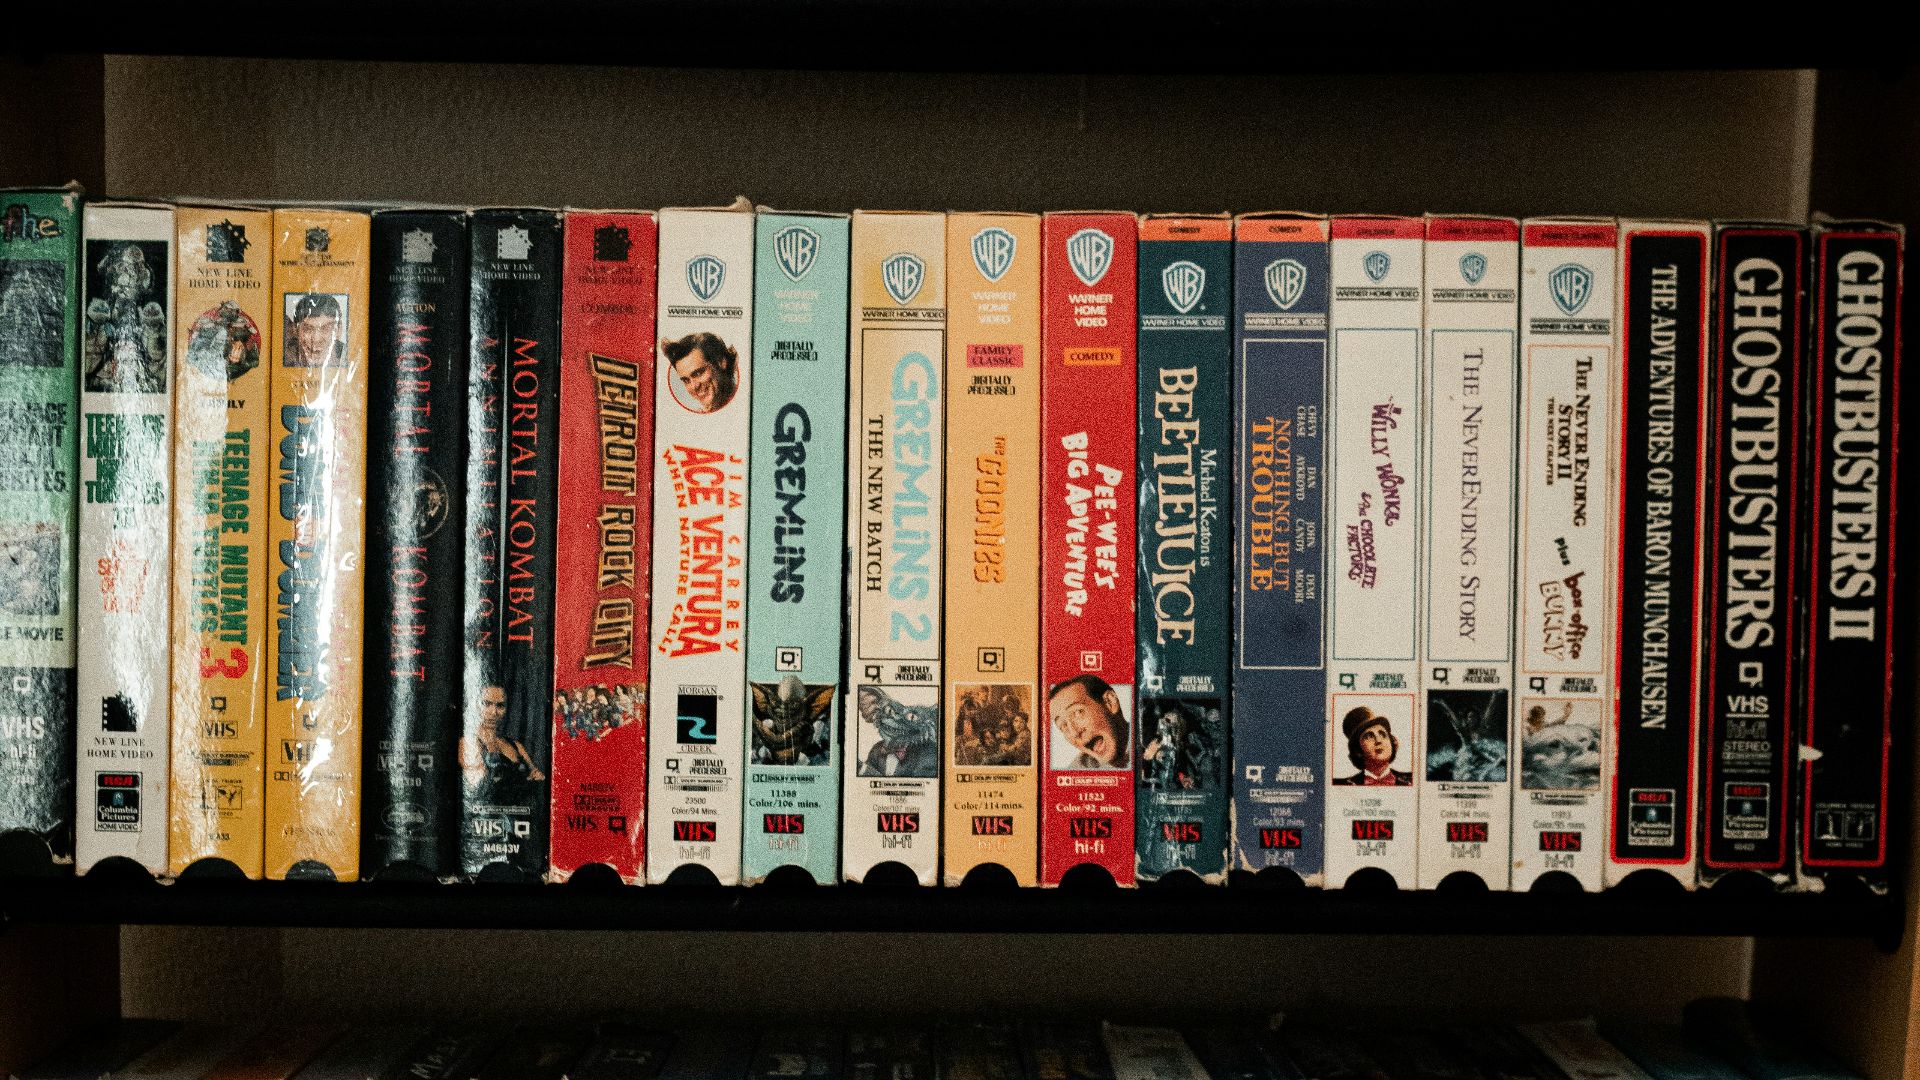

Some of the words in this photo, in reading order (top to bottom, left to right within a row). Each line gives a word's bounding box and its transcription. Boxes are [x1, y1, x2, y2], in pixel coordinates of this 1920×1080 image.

[198, 268, 222, 277] NEW
[226, 268, 252, 278] LINE
[777, 229, 817, 280] WB
[974, 230, 1013, 280] WB
[1070, 232, 1110, 284] WB
[189, 279, 220, 288] HOME
[226, 280, 261, 289] VIDEO
[484, 272, 509, 280] HOME
[689, 258, 723, 299] WB
[885, 256, 922, 302] WB
[1166, 264, 1202, 309] WB
[1268, 262, 1303, 306] WB
[1552, 267, 1589, 313] WB
[1651, 263, 1678, 310] THE
[1069, 294, 1113, 303] WARNER
[1074, 306, 1107, 316] HOME
[978, 316, 1012, 324] VIDEO
[1075, 318, 1108, 327] VIDEO
[1142, 319, 1175, 327] WARNER
[1245, 318, 1275, 326] WARNER
[1277, 318, 1301, 326] HOME
[972, 356, 1015, 366] CLASSIC
[974, 346, 1013, 354] FAMILY
[1070, 352, 1115, 362] COMEDY
[395, 321, 432, 457] MORTAL
[972, 376, 1012, 385] DIGITALLY
[1462, 348, 1484, 396] THE
[1576, 356, 1593, 391] THE
[1648, 312, 1677, 464] ADVENTURES
[510, 337, 540, 486] MORTAL
[590, 352, 640, 498] DETROIT
[1296, 405, 1306, 437] CHASE
[1307, 405, 1317, 438] CHEVY
[1371, 403, 1398, 458] WILLY
[1575, 394, 1591, 455] NEVER
[1828, 249, 1886, 599] GHOSTBUSTERS
[866, 414, 884, 459] THE
[1557, 404, 1573, 461] STORY
[1724, 256, 1785, 650] GHOSTBUSTERS
[672, 444, 725, 507] ACE
[1061, 431, 1089, 479] BIG
[1200, 448, 1218, 502] Michael
[1546, 443, 1554, 486] CHAPTER
[1557, 463, 1572, 479] II
[221, 428, 250, 534] TEENAGE
[662, 448, 688, 509] WHEN
[728, 455, 742, 509] JIM
[866, 466, 884, 516] NEW
[1274, 418, 1292, 537] NOTHING
[1296, 455, 1306, 501] AYKROYD
[1307, 467, 1316, 489] DAN
[1375, 462, 1405, 527] WONKA
[1647, 467, 1673, 498] OF
[973, 453, 1008, 584] GOONIES
[1152, 366, 1200, 646] BEETLEJUICE
[1251, 416, 1275, 591] TROUBLE
[596, 503, 637, 589] ROCK
[1093, 463, 1123, 591] PEE-WEE'S
[1200, 504, 1218, 554] Keaton
[1295, 518, 1305, 554] CANDY
[1306, 521, 1316, 548] JOHN
[1645, 500, 1673, 576] BARON
[677, 517, 690, 596] NATURE
[866, 521, 883, 593] BATCH
[1062, 483, 1093, 618] ADVENTURE
[1200, 555, 1210, 567] is
[1274, 540, 1290, 592] BUT
[1346, 524, 1364, 581] FACTORY
[1361, 519, 1377, 590] CHOCOLATE
[191, 526, 219, 633] TURTLES
[507, 498, 537, 649] KOMBAT
[669, 513, 724, 658] VENTURA
[725, 535, 741, 652] CARREY
[1295, 569, 1304, 604] MOORE
[1306, 574, 1315, 600] DEMI
[220, 545, 249, 645] MUTANT
[390, 545, 429, 682] KOMBAT
[1459, 574, 1481, 643] STORY
[581, 597, 636, 670] CITY
[657, 603, 683, 654] CALLS
[890, 611, 932, 642] 2
[1539, 580, 1565, 662] BUNNY
[1828, 606, 1876, 642] II
[199, 647, 249, 678] 3
[1641, 580, 1670, 730] MUNCHAUSEN
[678, 685, 718, 695] MORGAN
[1727, 695, 1769, 713] VHS
[1, 716, 45, 739] VHS
[94, 737, 119, 746] NEW
[121, 738, 145, 746] LINE
[203, 722, 236, 737] VHS
[1723, 741, 1771, 752] STEREO
[87, 750, 117, 758] HOME
[121, 751, 153, 759] VIDEO
[104, 776, 132, 786] RCA
[771, 790, 797, 798] 11388
[99, 805, 137, 814] Columbia
[101, 813, 135, 821] Pictures
[567, 816, 597, 830] VHS
[672, 807, 700, 815] Color/94
[749, 799, 793, 808] Color/106
[797, 799, 821, 808] mins.
[765, 815, 803, 833] VHS
[880, 814, 917, 831] VHS
[1100, 804, 1124, 813] mins.
[473, 820, 504, 836] VHS
[676, 822, 715, 841] VHS
[974, 817, 1011, 834] VHS
[1072, 818, 1110, 837] VHS
[1162, 823, 1200, 841] VHS
[1262, 829, 1301, 847] VHS
[1354, 821, 1392, 840] VHS
[1449, 823, 1487, 842] VHS
[1542, 832, 1581, 850] VHS
[1074, 840, 1104, 854] hi-fi
